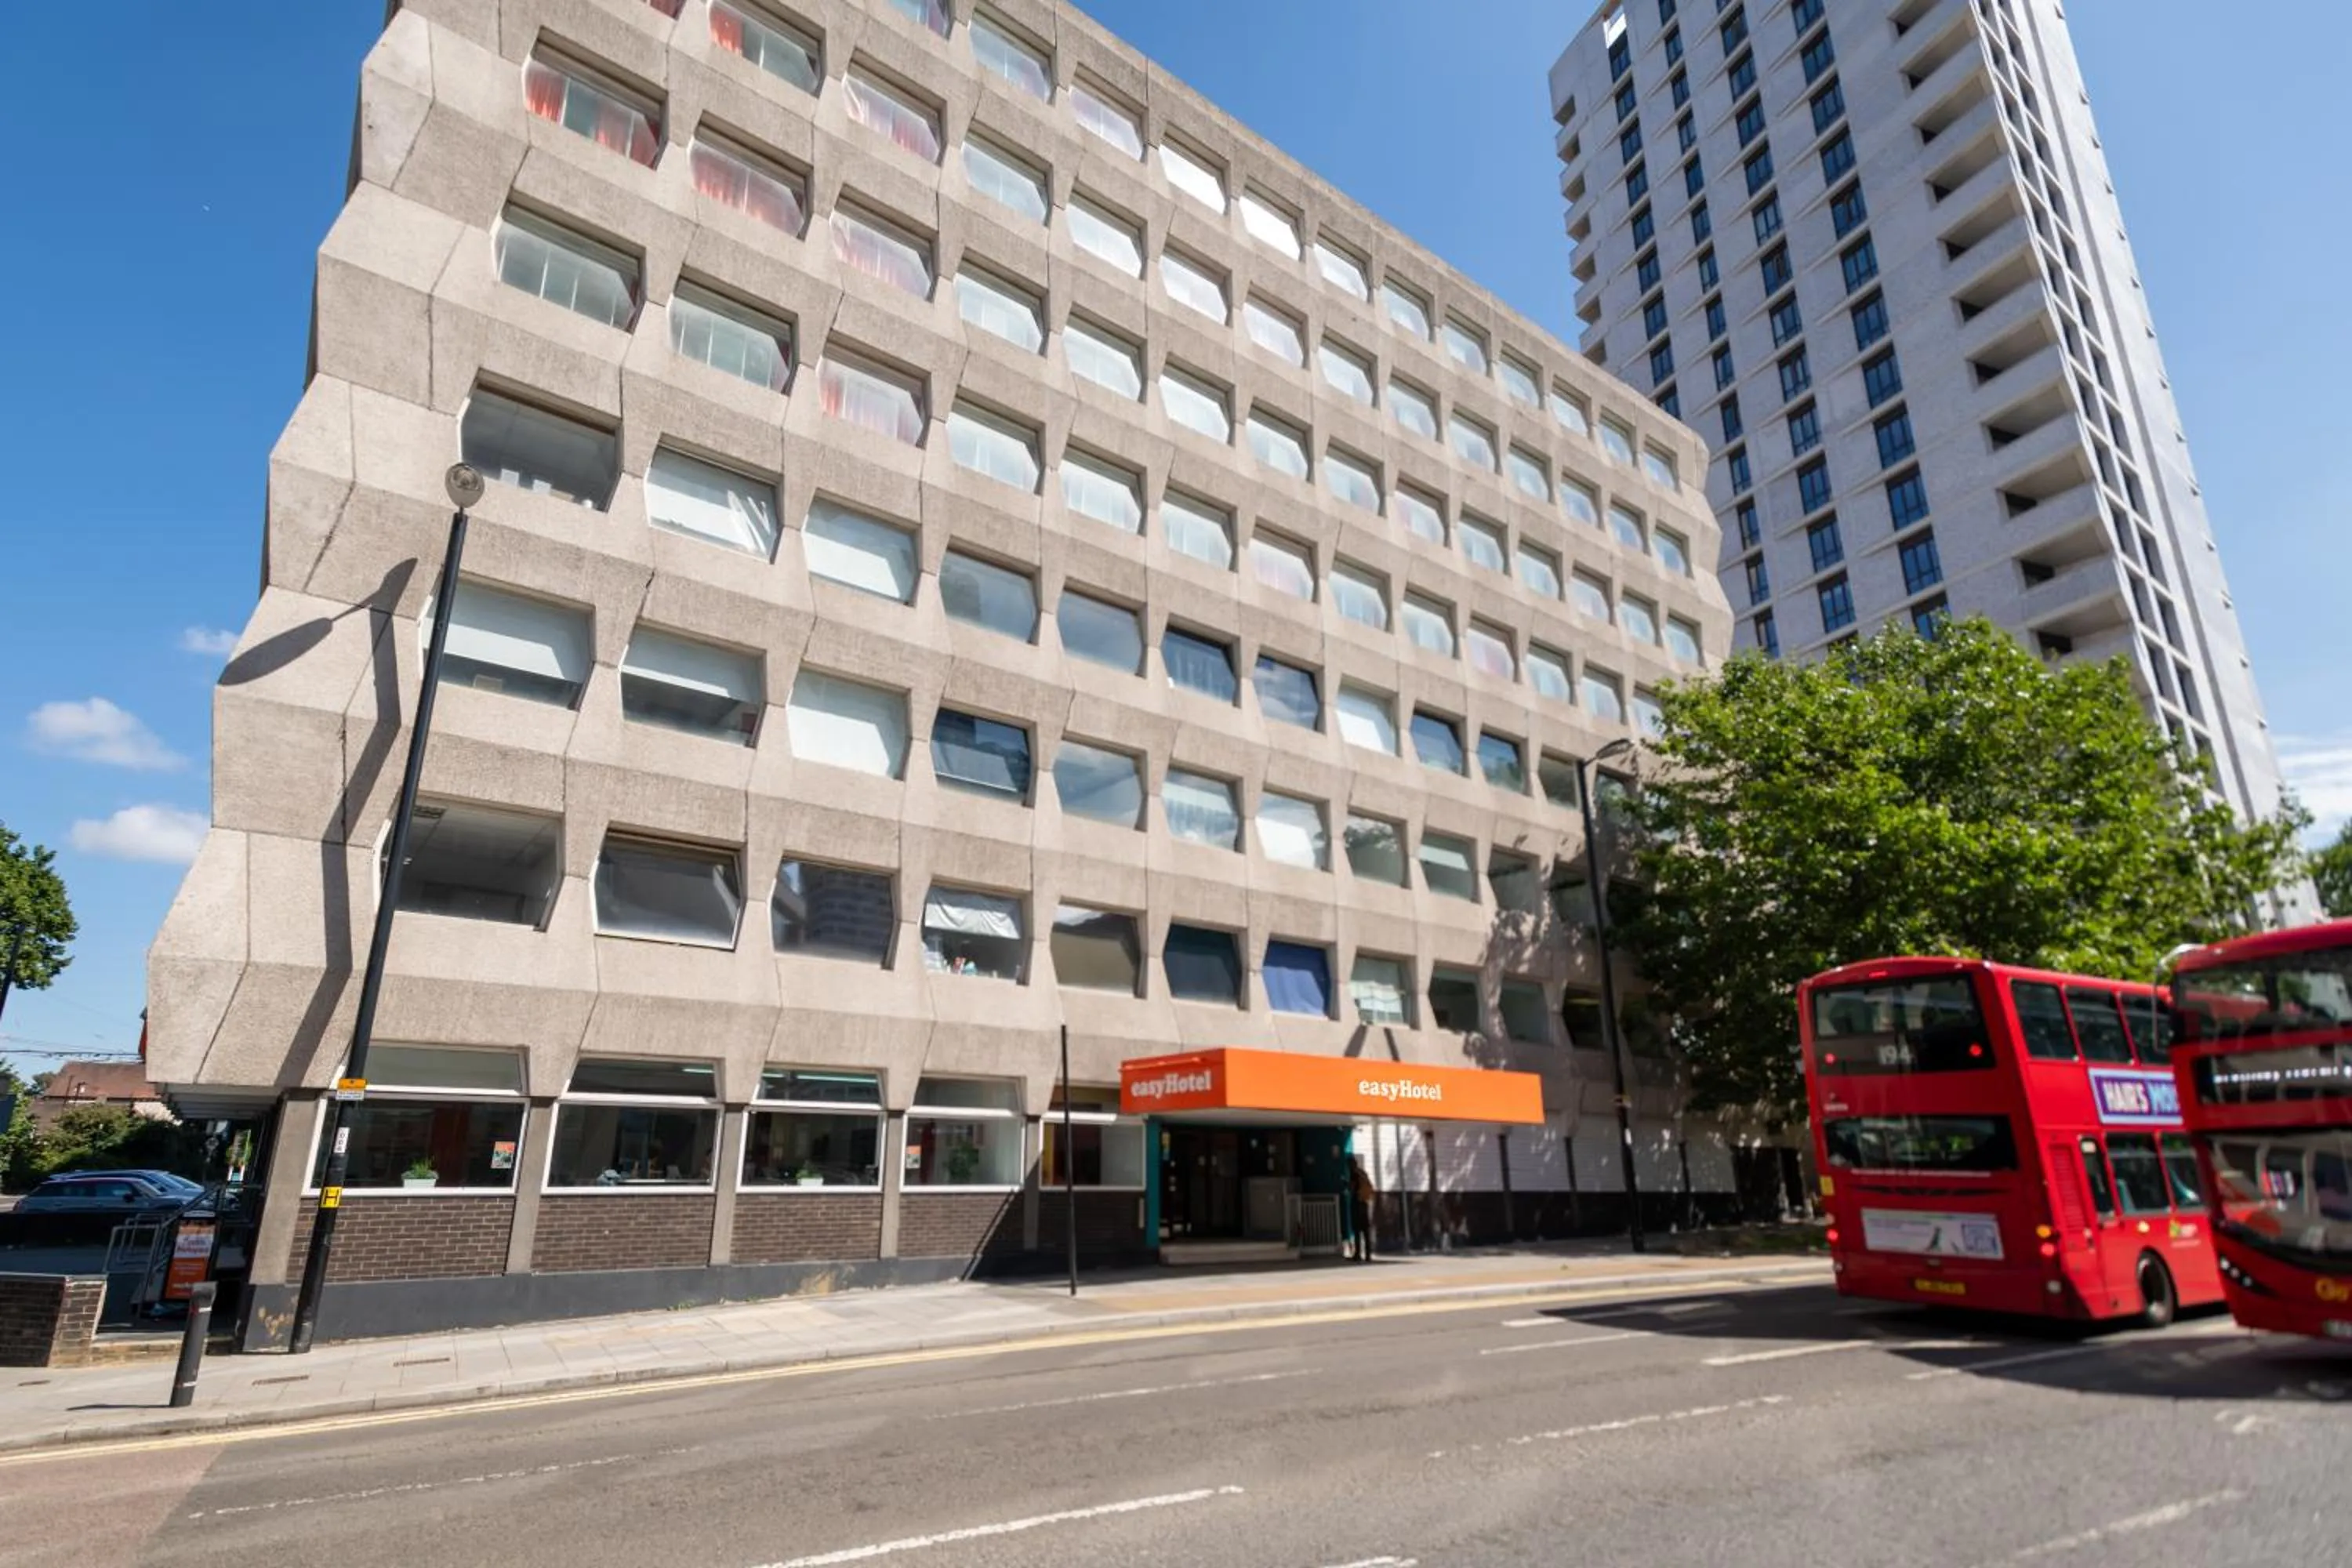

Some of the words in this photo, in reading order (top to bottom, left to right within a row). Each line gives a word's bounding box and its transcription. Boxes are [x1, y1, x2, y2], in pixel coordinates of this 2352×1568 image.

[1878, 1044, 1913, 1065] 194
[1131, 1069, 1211, 1099] easyHotel
[1359, 1079, 1442, 1102] easyHotel
[323, 1188, 339, 1205] H
